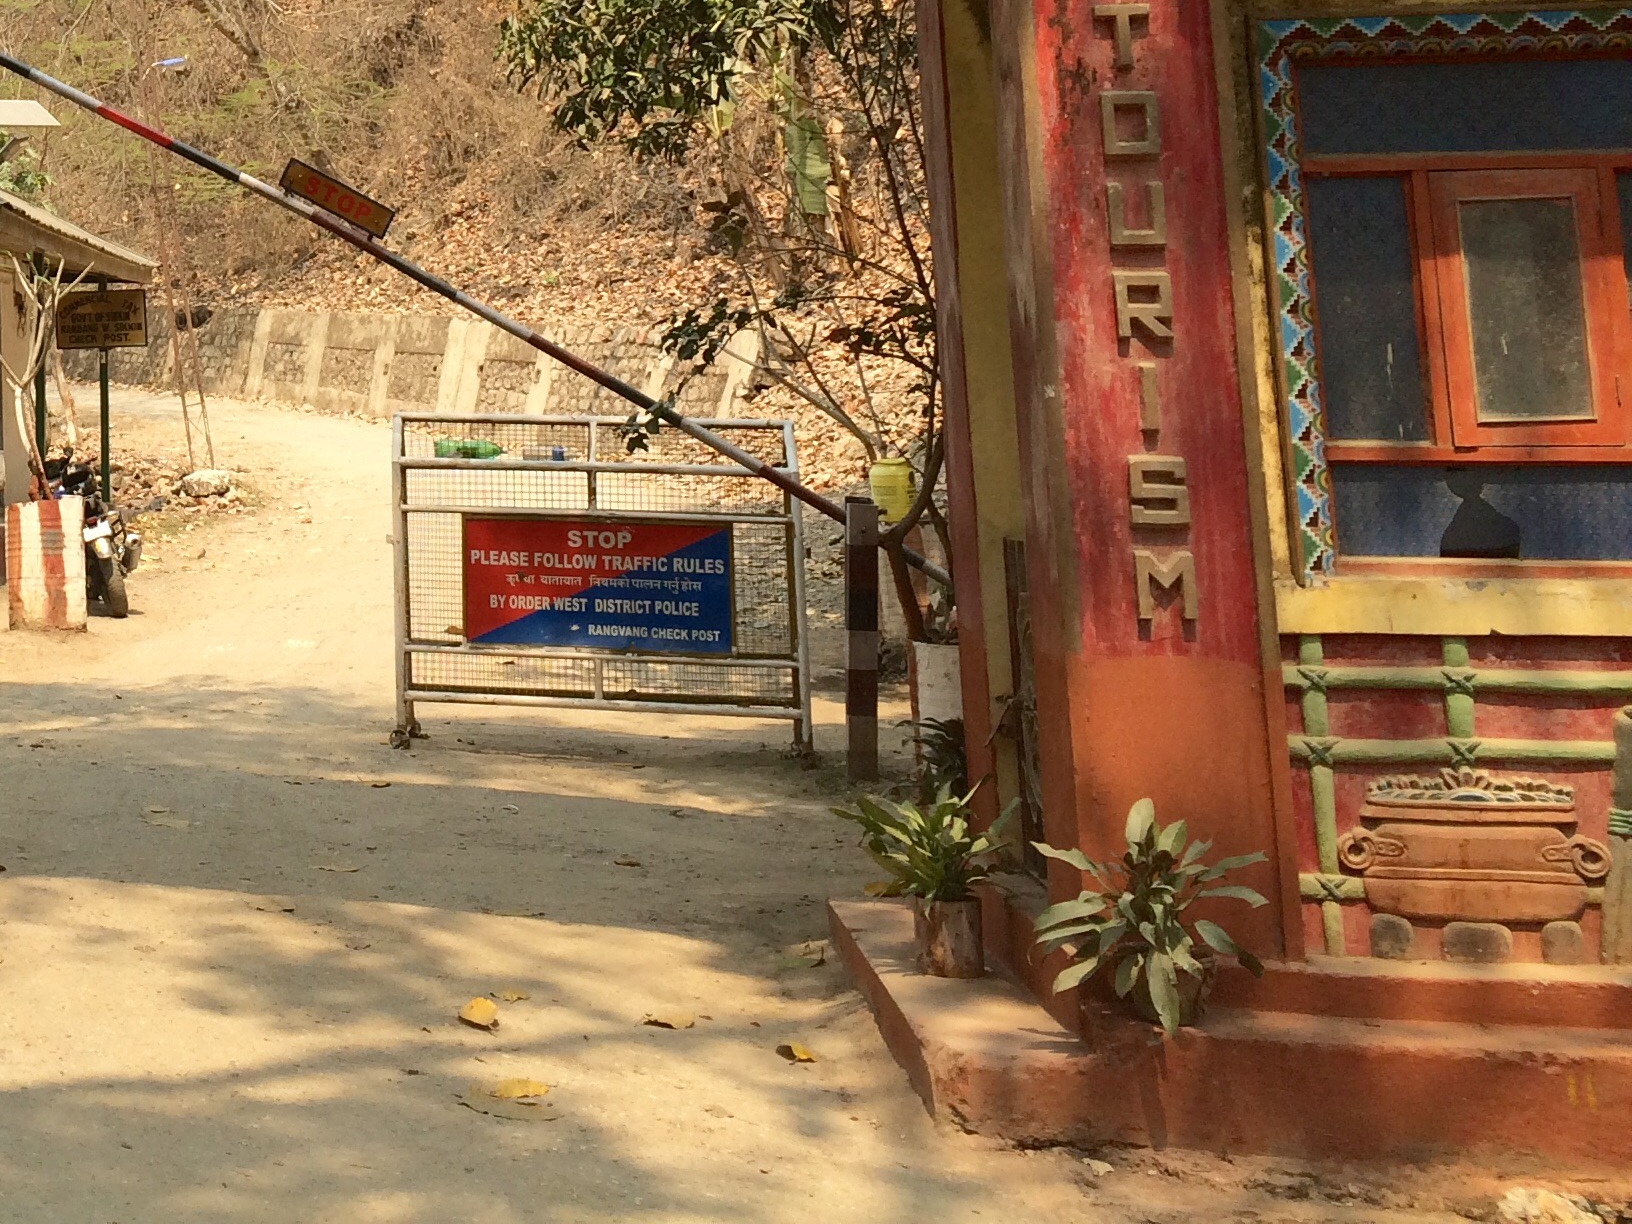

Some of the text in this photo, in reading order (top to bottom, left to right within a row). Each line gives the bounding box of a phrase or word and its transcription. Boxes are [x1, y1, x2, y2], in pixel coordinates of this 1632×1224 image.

[304, 175, 372, 220] STOP
[121, 298, 140, 315] TAX
[1093, 3, 1198, 626] TOURISM
[69, 335, 97, 343] CHECK
[568, 530, 633, 548] STOP
[471, 550, 725, 574] PLEASE FOLLOW TRAFFIC RULES
[490, 595, 699, 616] BY ORDER WEST DISTRICT POLICE
[588, 624, 720, 642] RANGVANG CHECK POST
